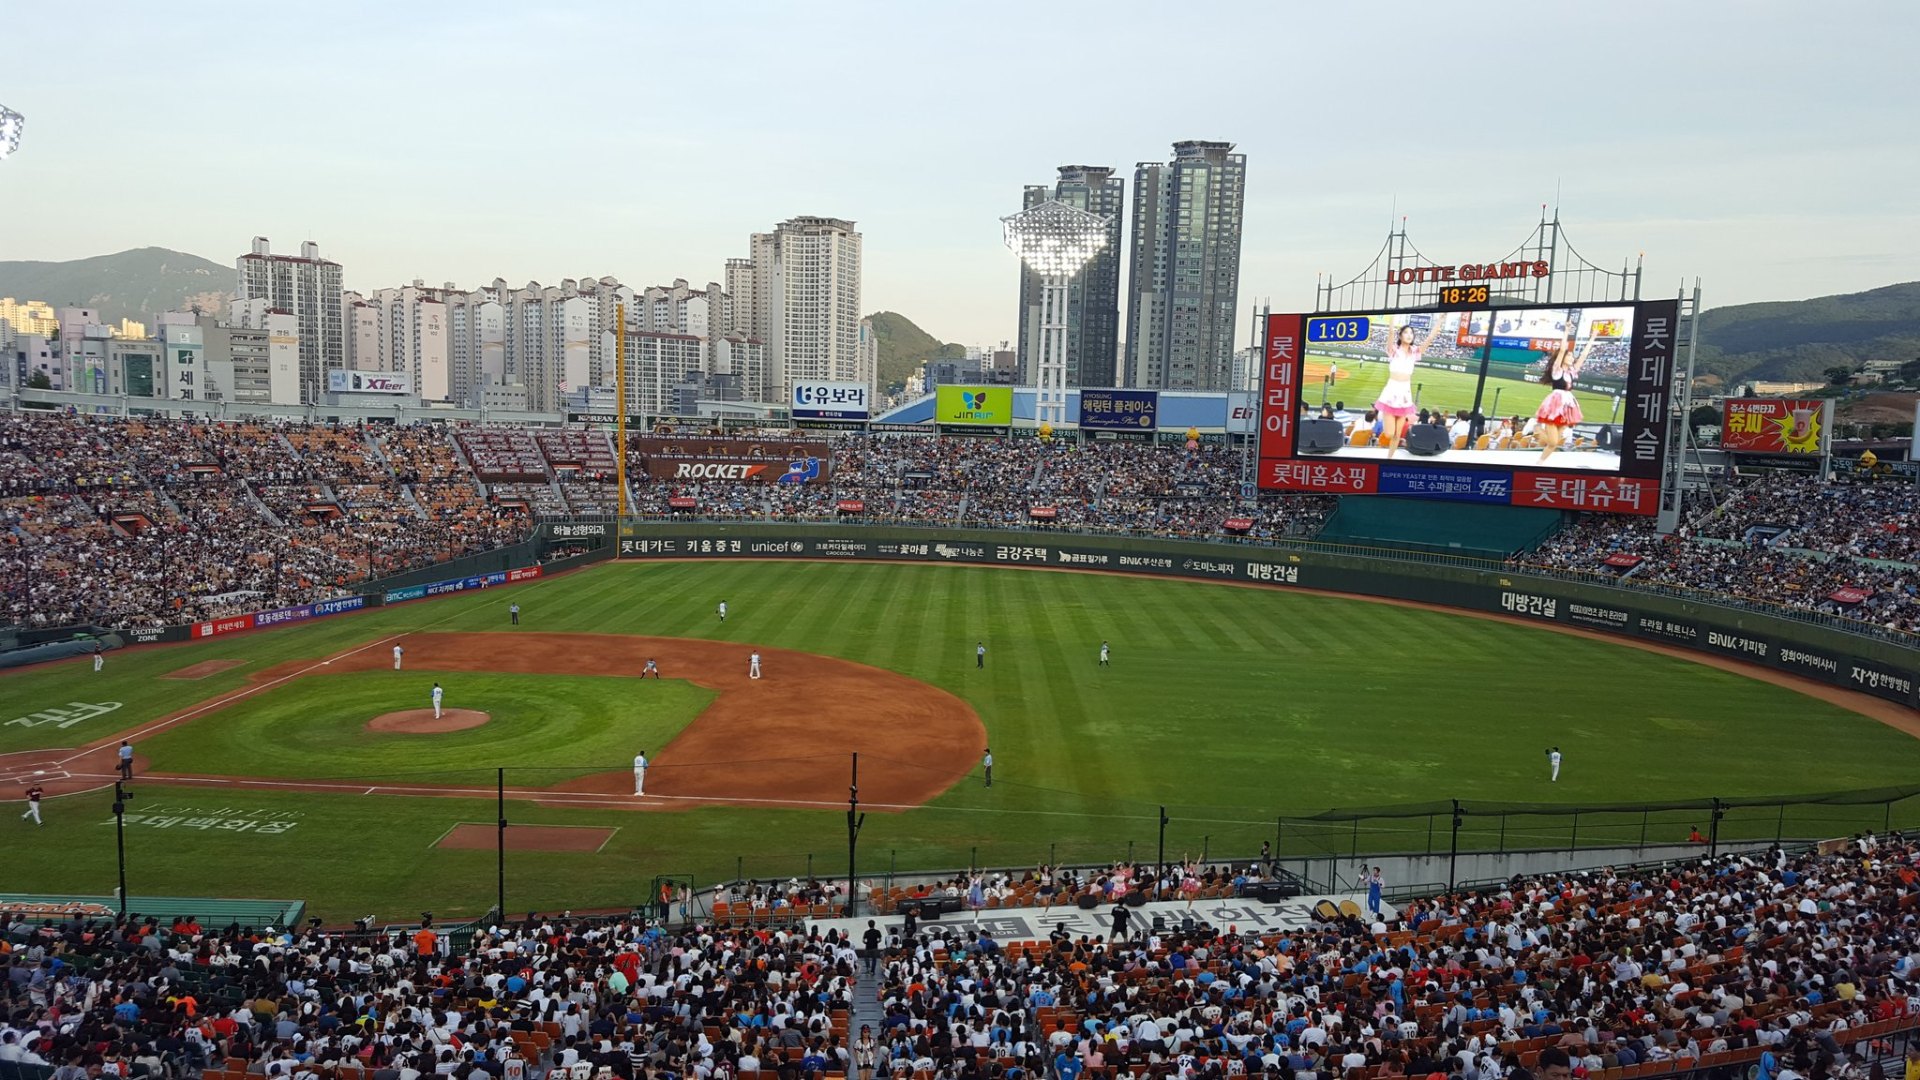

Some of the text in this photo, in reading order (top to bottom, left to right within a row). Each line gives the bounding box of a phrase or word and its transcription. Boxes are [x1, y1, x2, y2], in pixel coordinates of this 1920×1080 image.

[1387, 260, 1549, 285] LOTTE GIANTS
[1442, 287, 1487, 304] 18:26
[1318, 321, 1358, 339] 1:03
[365, 378, 405, 391] XTeer
[1265, 336, 1294, 438] 롯데리아
[1633, 317, 1669, 461] 롯데캐슬
[813, 386, 865, 406] 유보라
[1083, 399, 1155, 414] 해링턴 플레이스
[674, 463, 753, 480] ROCKET
[1272, 463, 1366, 490] 롯데홈쇼핑
[1382, 471, 1402, 479] SUPER
[1408, 480, 1472, 493] 피츠 수퍼클리어
[1533, 476, 1641, 510] 롯데슈퍼
[553, 525, 605, 536] 하늘성형외과
[621, 540, 676, 553] 롯데카드
[687, 540, 742, 553] 키움증권
[751, 541, 789, 553] unicef
[815, 543, 867, 551] 크로커다일레이디
[900, 544, 929, 555] 꽃마름
[996, 546, 1048, 562] 금강주택
[1119, 556, 1172, 569] BNK 부산은행
[1192, 561, 1235, 575] 도미노피자
[1246, 562, 1299, 584] 대방건설
[1501, 591, 1557, 618] 대방건설
[130, 627, 165, 636] EXCITING
[1639, 618, 1663, 631] 프라임
[1708, 631, 1738, 650] BNK
[1738, 638, 1768, 657] 캐피탈
